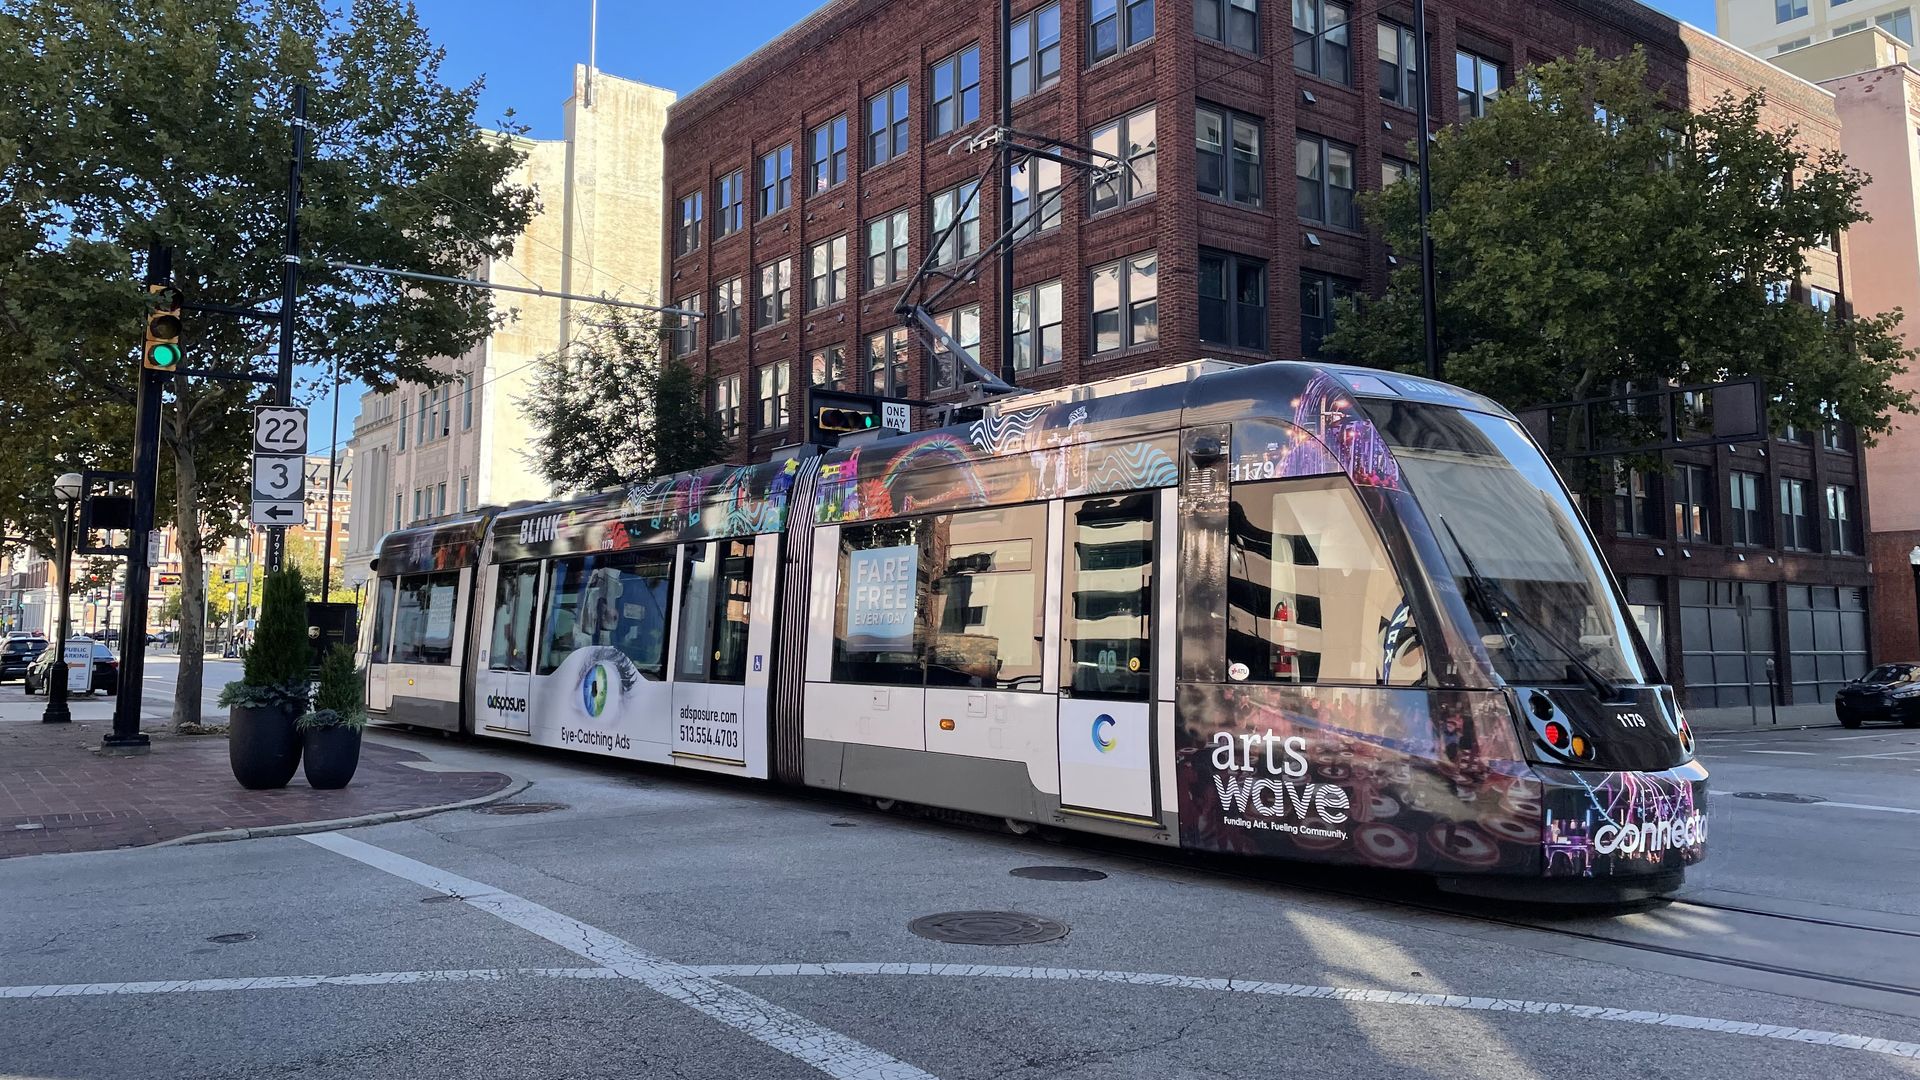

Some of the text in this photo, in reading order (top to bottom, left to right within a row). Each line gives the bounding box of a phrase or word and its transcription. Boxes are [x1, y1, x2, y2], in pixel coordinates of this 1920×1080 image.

[886, 405, 906, 417] ONE
[886, 417, 906, 429] WAY
[264, 417, 298, 444] 22
[269, 463, 289, 490] 3
[1232, 460, 1275, 481] 1179
[520, 513, 562, 545] BLINK
[857, 555, 911, 584] FARE
[855, 583, 909, 611] FREE
[854, 610, 908, 626] EVERY DAY
[487, 688, 526, 717] adsposure
[679, 704, 738, 724] adsposure.com
[1616, 713, 1646, 728] 1179
[561, 726, 631, 751] Eye-Catching Ads
[679, 724, 738, 748] 513.554.4703
[1211, 728, 1309, 777] arts
[1212, 774, 1350, 824] wave
[1223, 816, 1349, 841] Funding Arts. Fueling Community.
